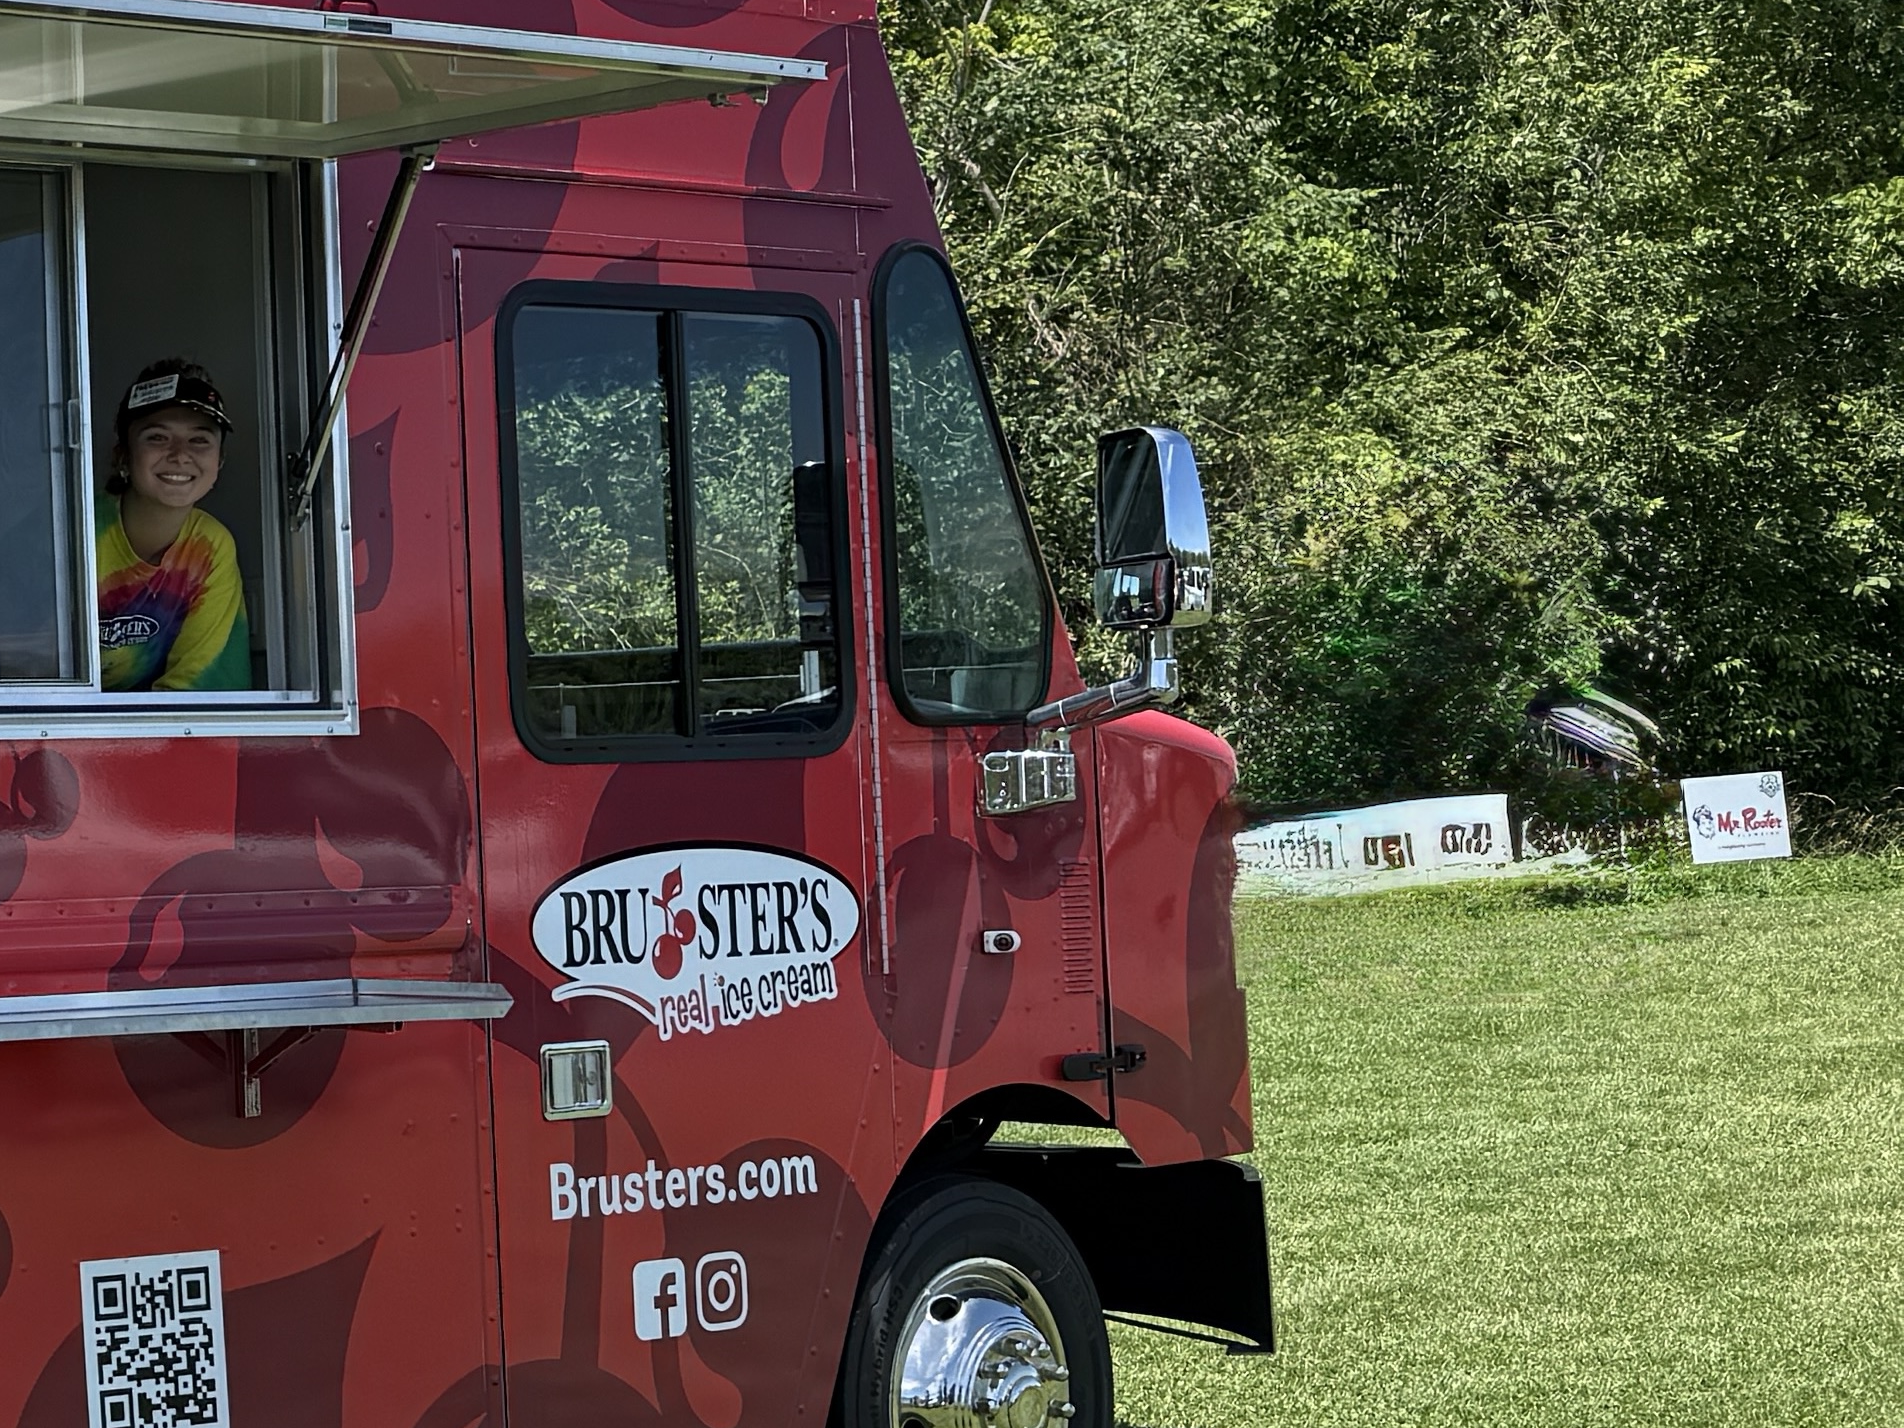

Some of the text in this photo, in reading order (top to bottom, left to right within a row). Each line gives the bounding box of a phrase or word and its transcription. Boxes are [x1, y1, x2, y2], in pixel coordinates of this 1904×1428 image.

[1742, 807, 1782, 832] Rooter
[559, 877, 833, 969] BRUSTER'S
[660, 961, 834, 1034] real ice cream
[549, 1154, 819, 1221] Brusters.com
